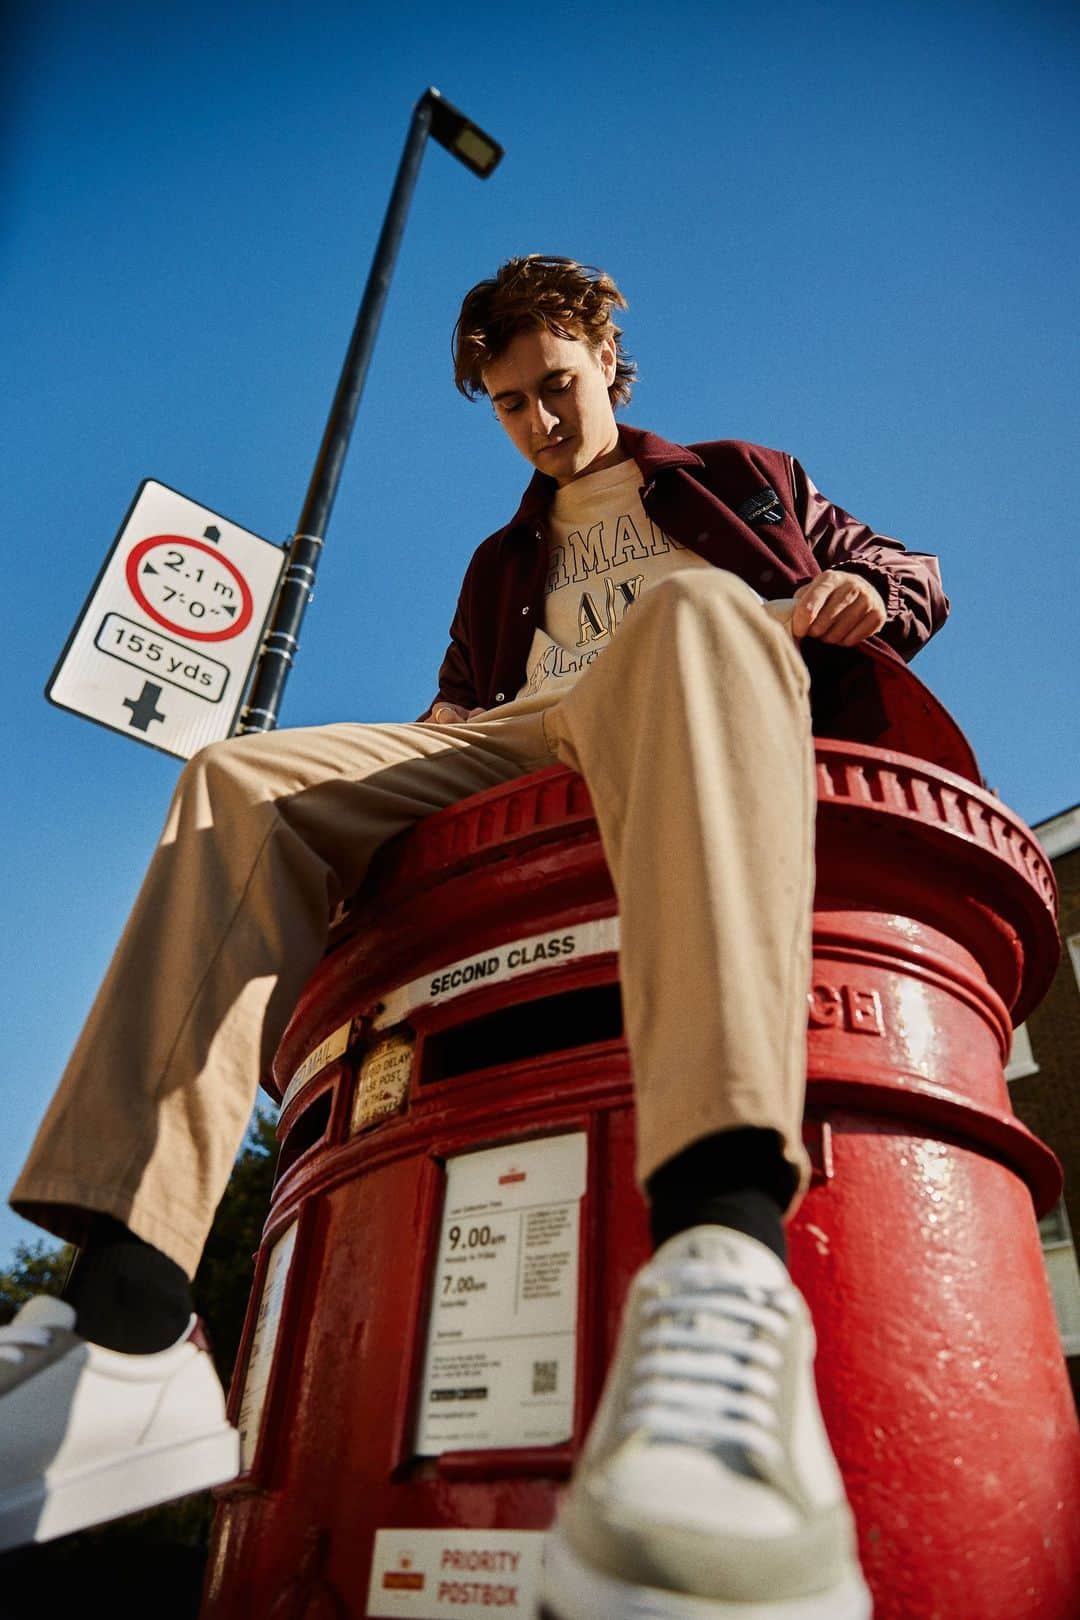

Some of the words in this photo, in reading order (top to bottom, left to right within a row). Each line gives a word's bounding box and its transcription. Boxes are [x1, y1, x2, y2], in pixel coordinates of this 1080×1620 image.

[163, 551, 205, 582] 2.1
[212, 581, 235, 599] m
[115, 629, 164, 662] 155
[166, 656, 214, 687] yds
[429, 956, 500, 997] SECOND
[506, 935, 576, 969] CLASS
[440, 1548, 521, 1573] PRIORITY
[437, 1580, 519, 1607] POSTBOX
